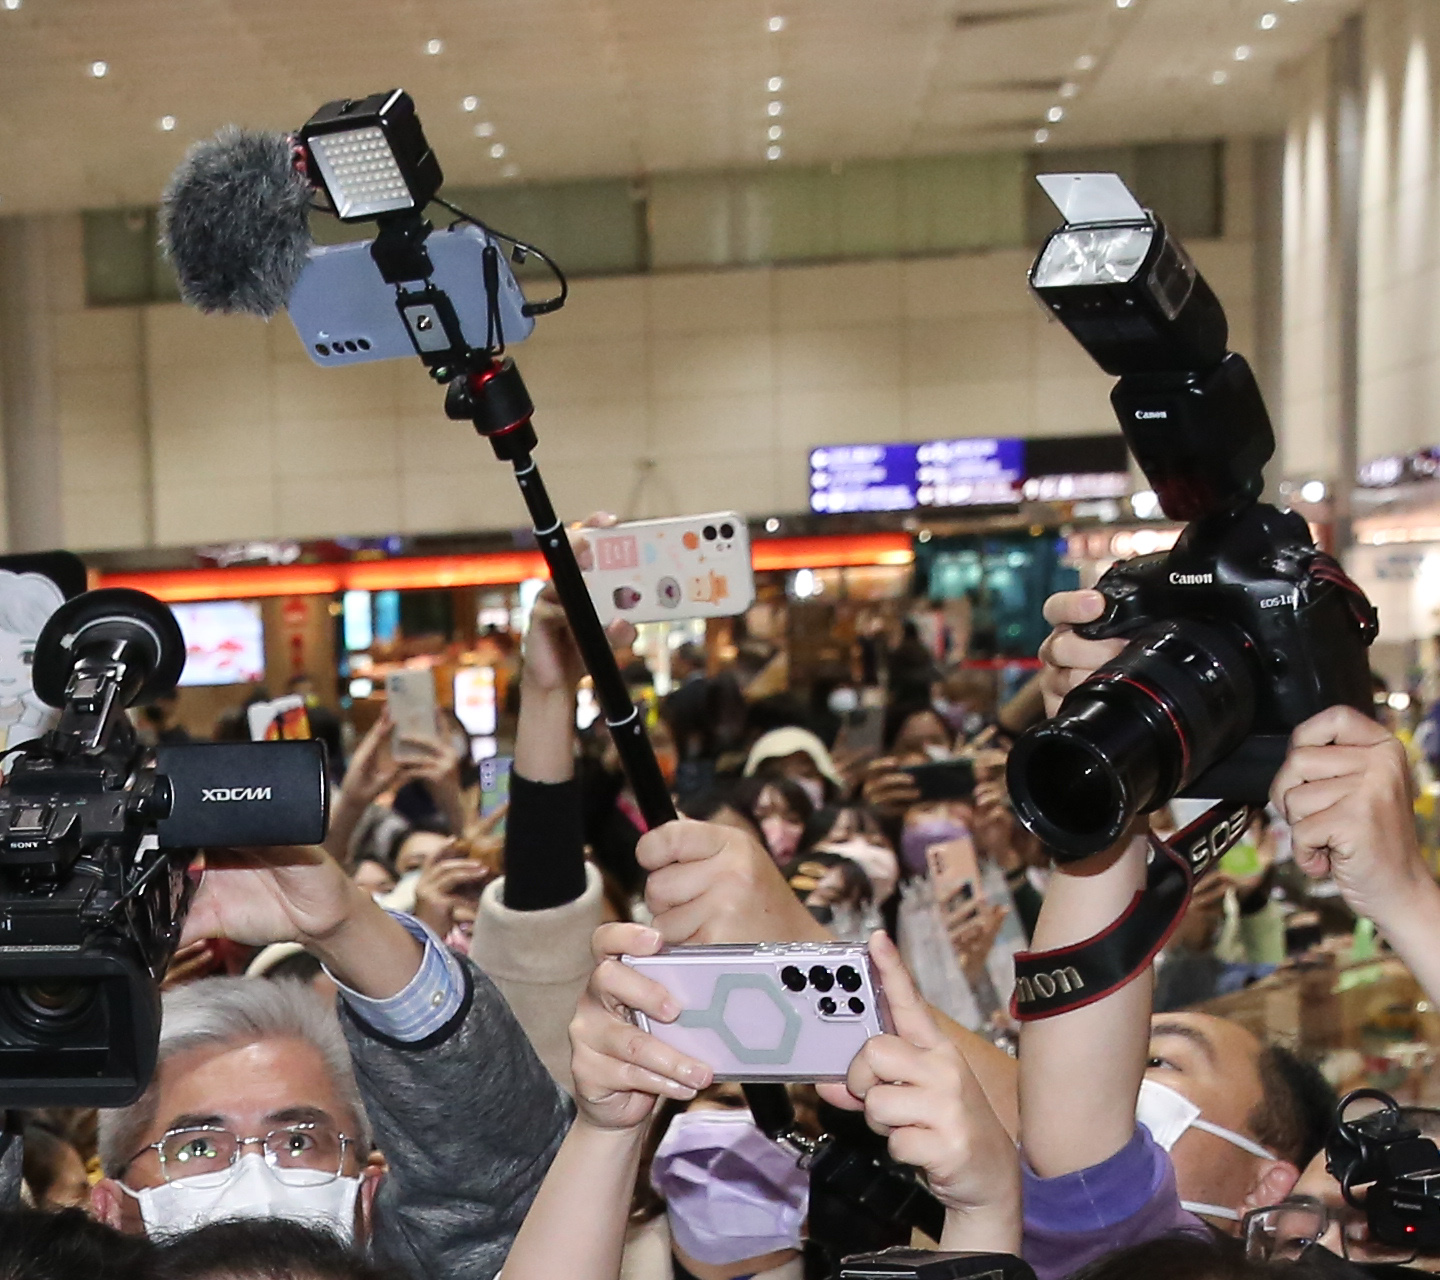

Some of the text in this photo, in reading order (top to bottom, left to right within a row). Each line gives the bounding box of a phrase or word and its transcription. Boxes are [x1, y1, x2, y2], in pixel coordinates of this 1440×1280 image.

[1134, 408, 1168, 420] Canon
[1169, 571, 1213, 585] Canon
[201, 786, 272, 802] XDCAM
